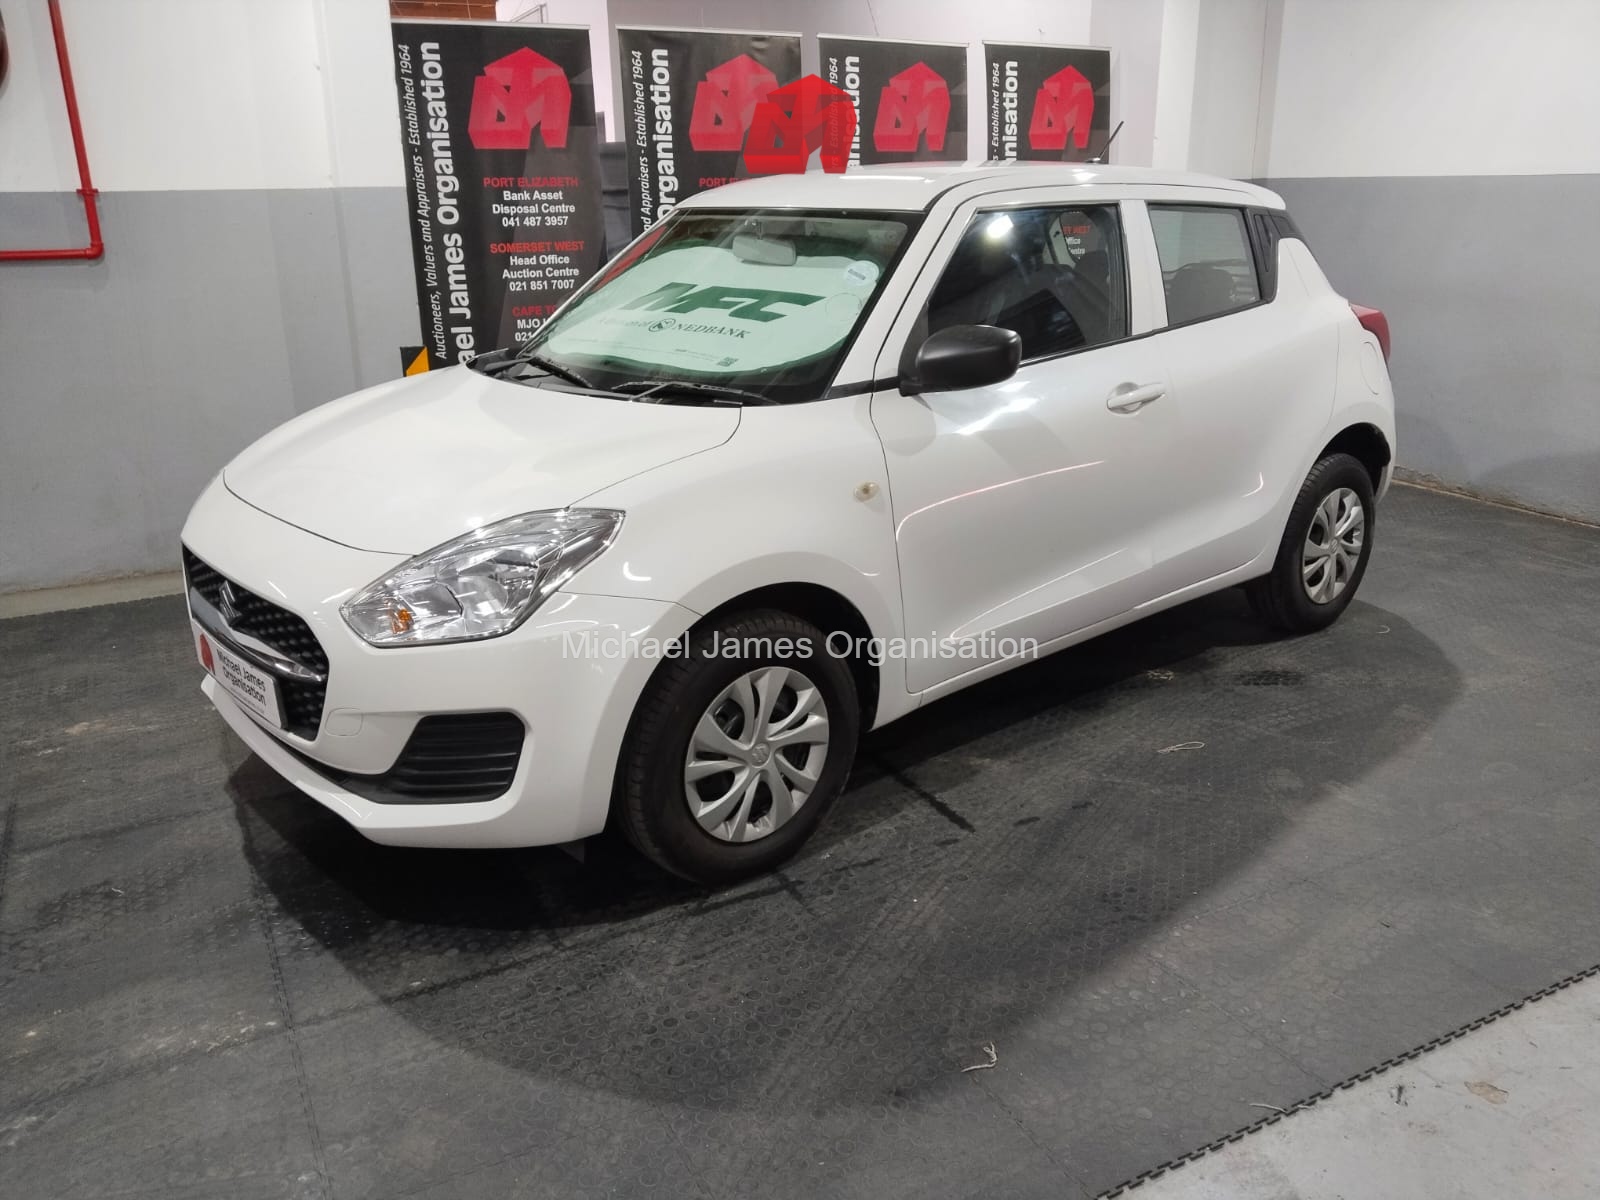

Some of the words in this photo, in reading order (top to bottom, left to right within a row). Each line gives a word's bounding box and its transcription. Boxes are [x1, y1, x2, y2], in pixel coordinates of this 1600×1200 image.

[398, 44, 412, 74] 1964
[631, 50, 643, 78] 1964
[829, 57, 838, 85] 1964
[992, 62, 1000, 88] 1964
[400, 77, 421, 146] Established
[633, 81, 647, 147] Established
[991, 89, 1000, 147] Established
[1002, 61, 1018, 160] nisation
[420, 42, 460, 226] Organisation
[412, 155, 431, 217] Appraisers
[483, 177, 514, 188] PORT
[517, 176, 579, 187] ELIZABETH
[503, 191, 531, 201] Bank
[533, 190, 563, 201] Asset
[638, 156, 652, 215] Appraisers
[492, 203, 538, 216] Disposal
[541, 203, 576, 213] Centre
[502, 217, 520, 227] 041
[522, 217, 542, 227] 487
[544, 216, 569, 226] 3957
[417, 219, 433, 242] and
[490, 242, 551, 254] SOMERSET
[554, 241, 585, 251] WEST
[510, 255, 537, 266] Head
[539, 255, 570, 265] Office
[424, 243, 438, 287] Valuers
[443, 233, 472, 319] James
[502, 268, 543, 279] Auction
[546, 267, 579, 278] Centre
[509, 280, 527, 291] 021
[530, 280, 549, 290] 851
[551, 279, 575, 290] 7007
[430, 290, 447, 359] Auctioneers,
[512, 305, 542, 317] CAPE
[517, 318, 540, 329] MJO
[672, 322, 752, 339] NEDBANK
